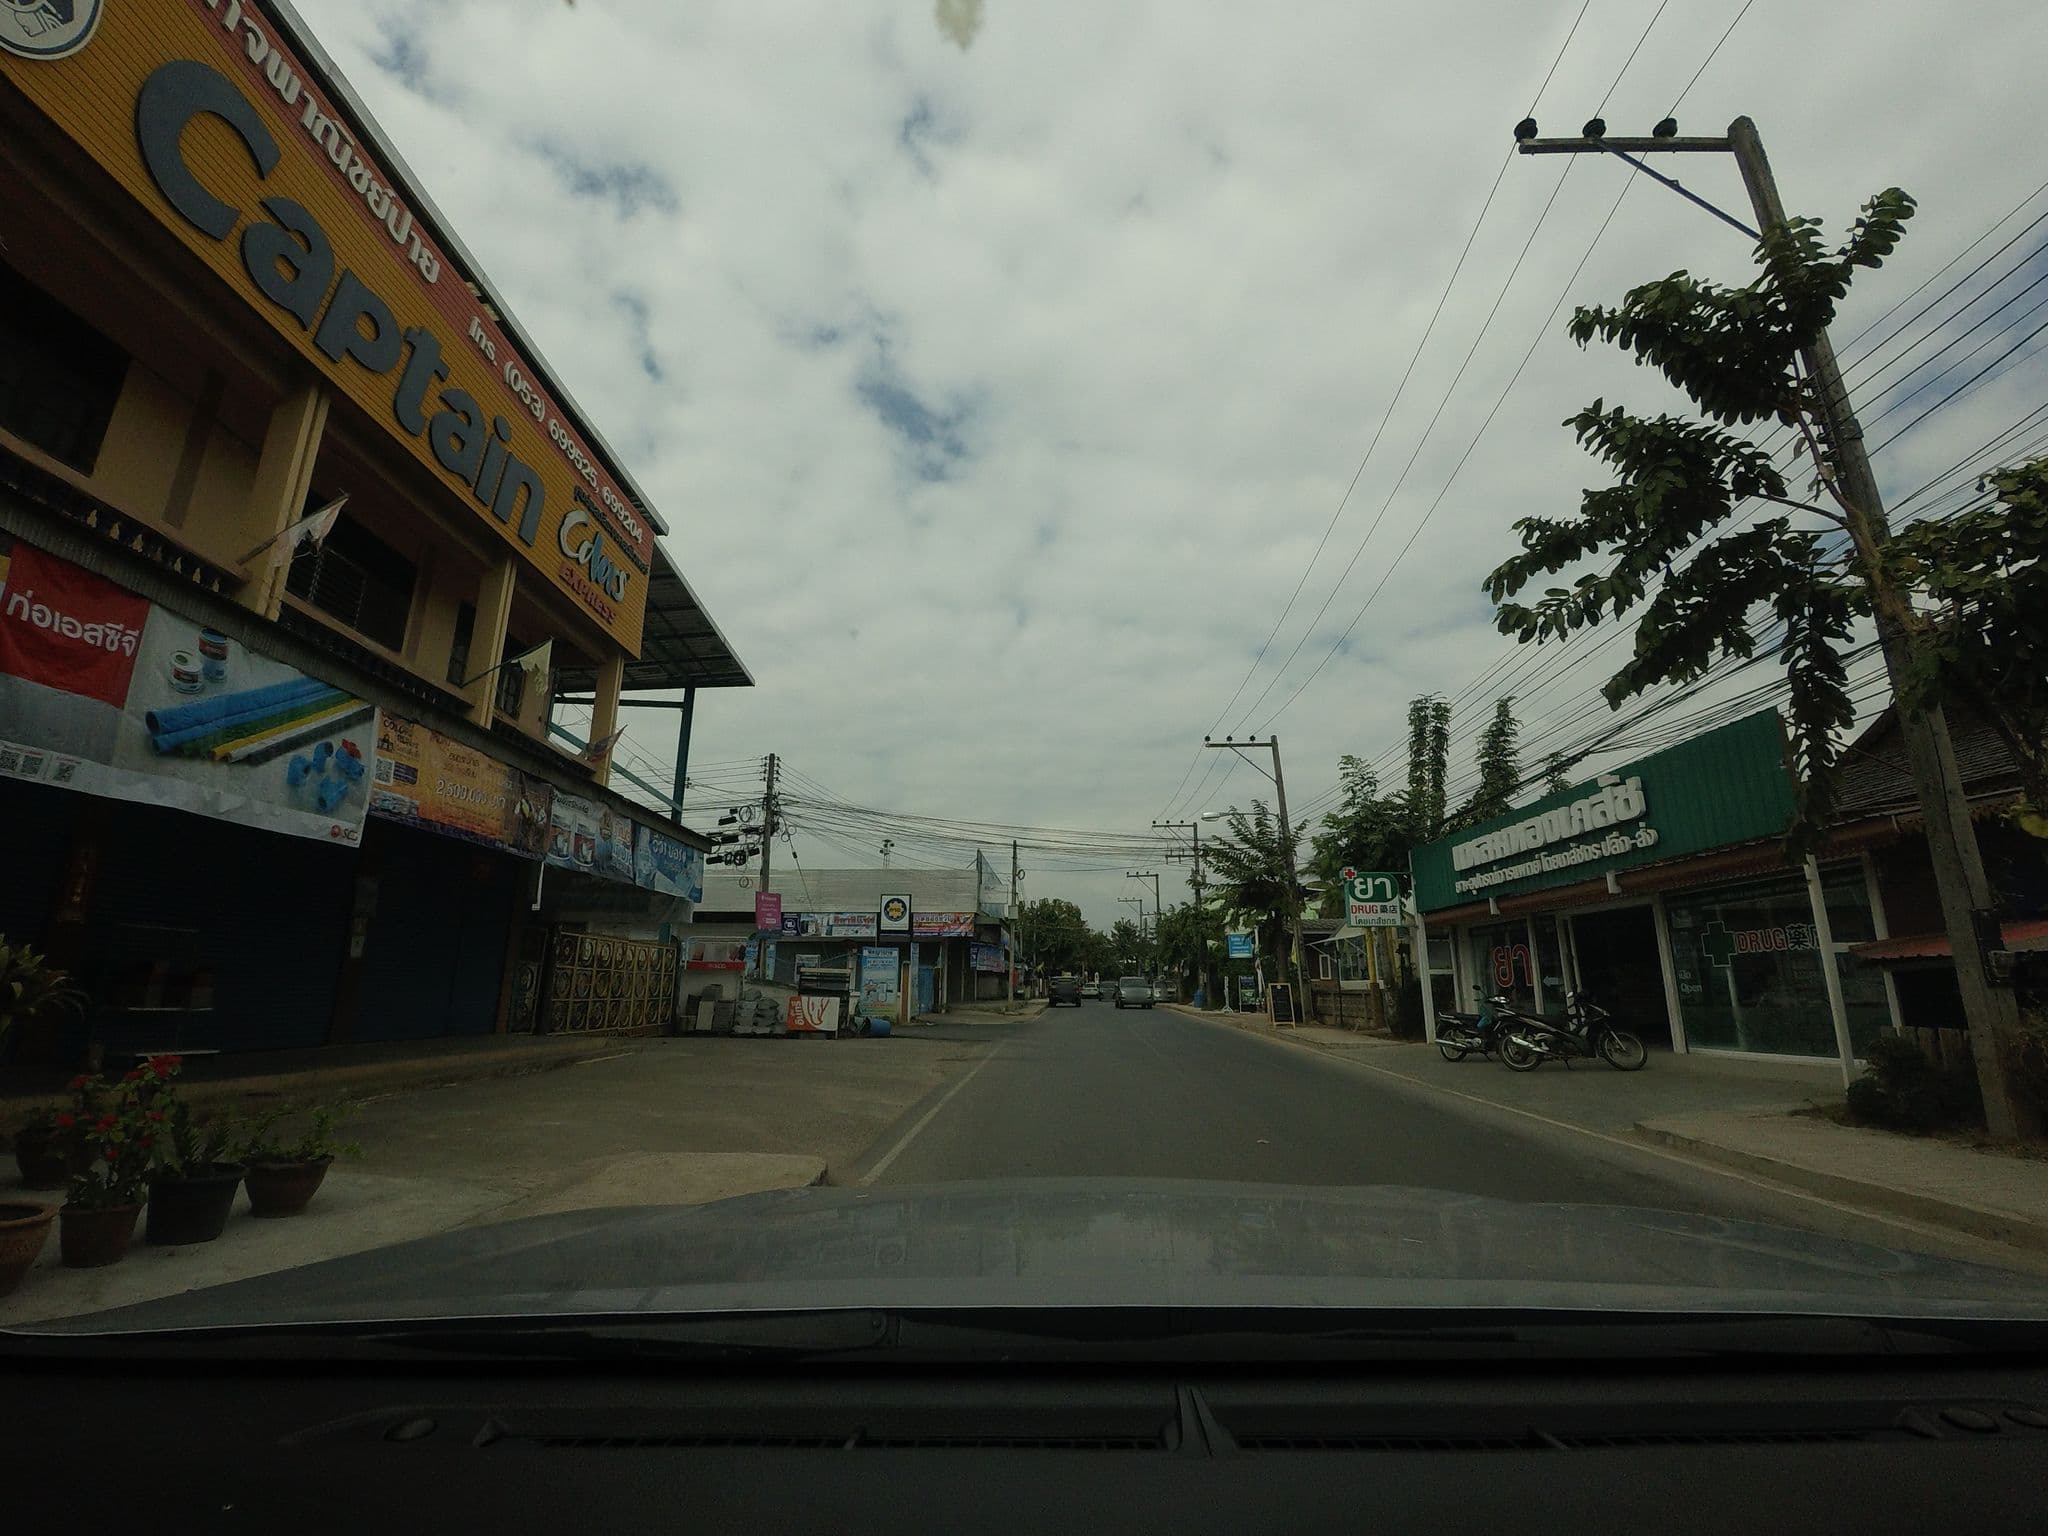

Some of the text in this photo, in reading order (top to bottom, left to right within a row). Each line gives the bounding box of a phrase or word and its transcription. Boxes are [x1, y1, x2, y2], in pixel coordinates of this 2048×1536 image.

[135, 59, 546, 547] Captain
[503, 360, 546, 422] (053)
[548, 418, 600, 494] 699525,
[602, 486, 643, 543] 699204
[558, 509, 629, 602] Colors
[6, 590, 141, 656] ท่อเอสซีจี
[1353, 876, 1394, 899] ยา
[1350, 904, 1379, 915] DRUG
[1735, 928, 1787, 953] DRUG
[1492, 944, 1534, 987] ยา
[1680, 983, 1703, 993] Open
